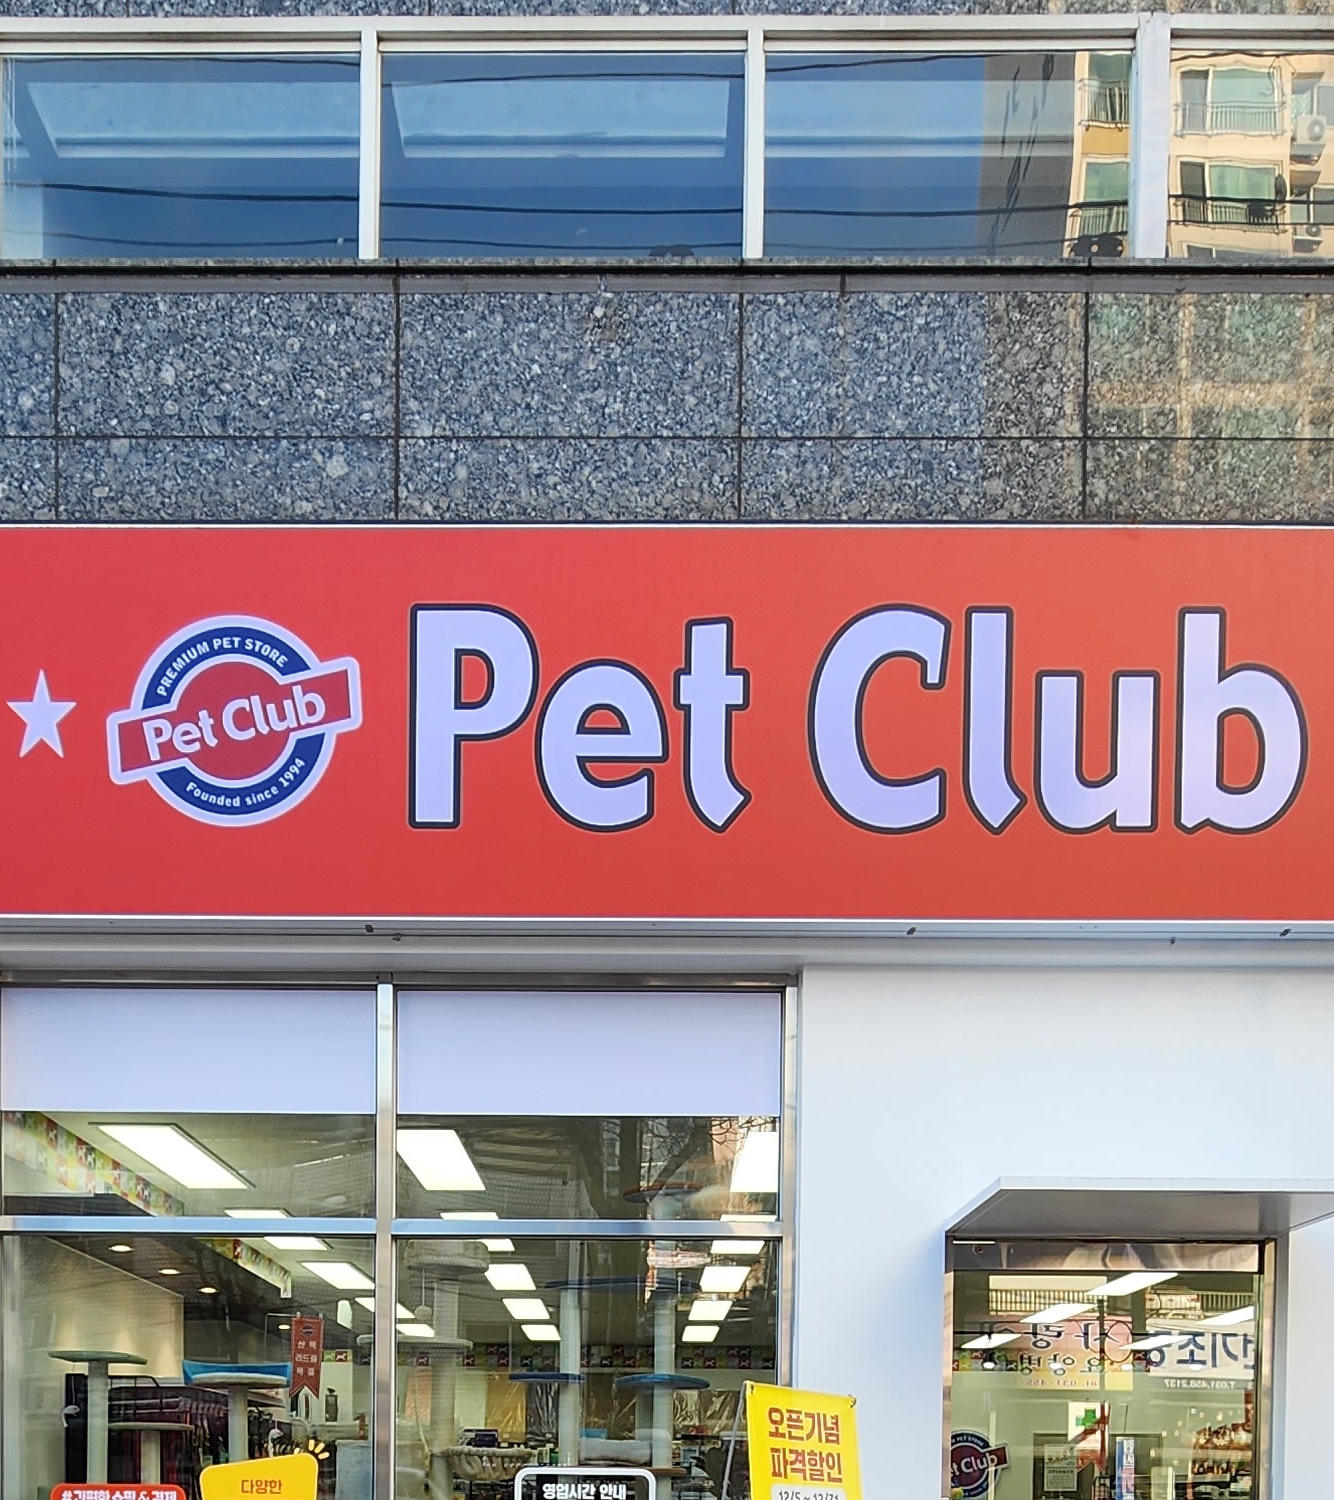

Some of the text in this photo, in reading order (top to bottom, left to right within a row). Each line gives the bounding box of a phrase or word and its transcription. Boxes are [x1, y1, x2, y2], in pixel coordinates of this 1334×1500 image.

[156, 636, 289, 697] PREMIUM PET STORE
[142, 685, 326, 761] Pet Club
[408, 603, 1309, 835] Pet Club
[185, 756, 306, 807] Founded since 1994
[767, 1406, 841, 1446] 오픈기념
[770, 1446, 843, 1484] 파격할인
[960, 1453, 998, 1473] Club
[240, 1478, 283, 1495] 다양한
[541, 1482, 628, 1500] 영업시간 안내
